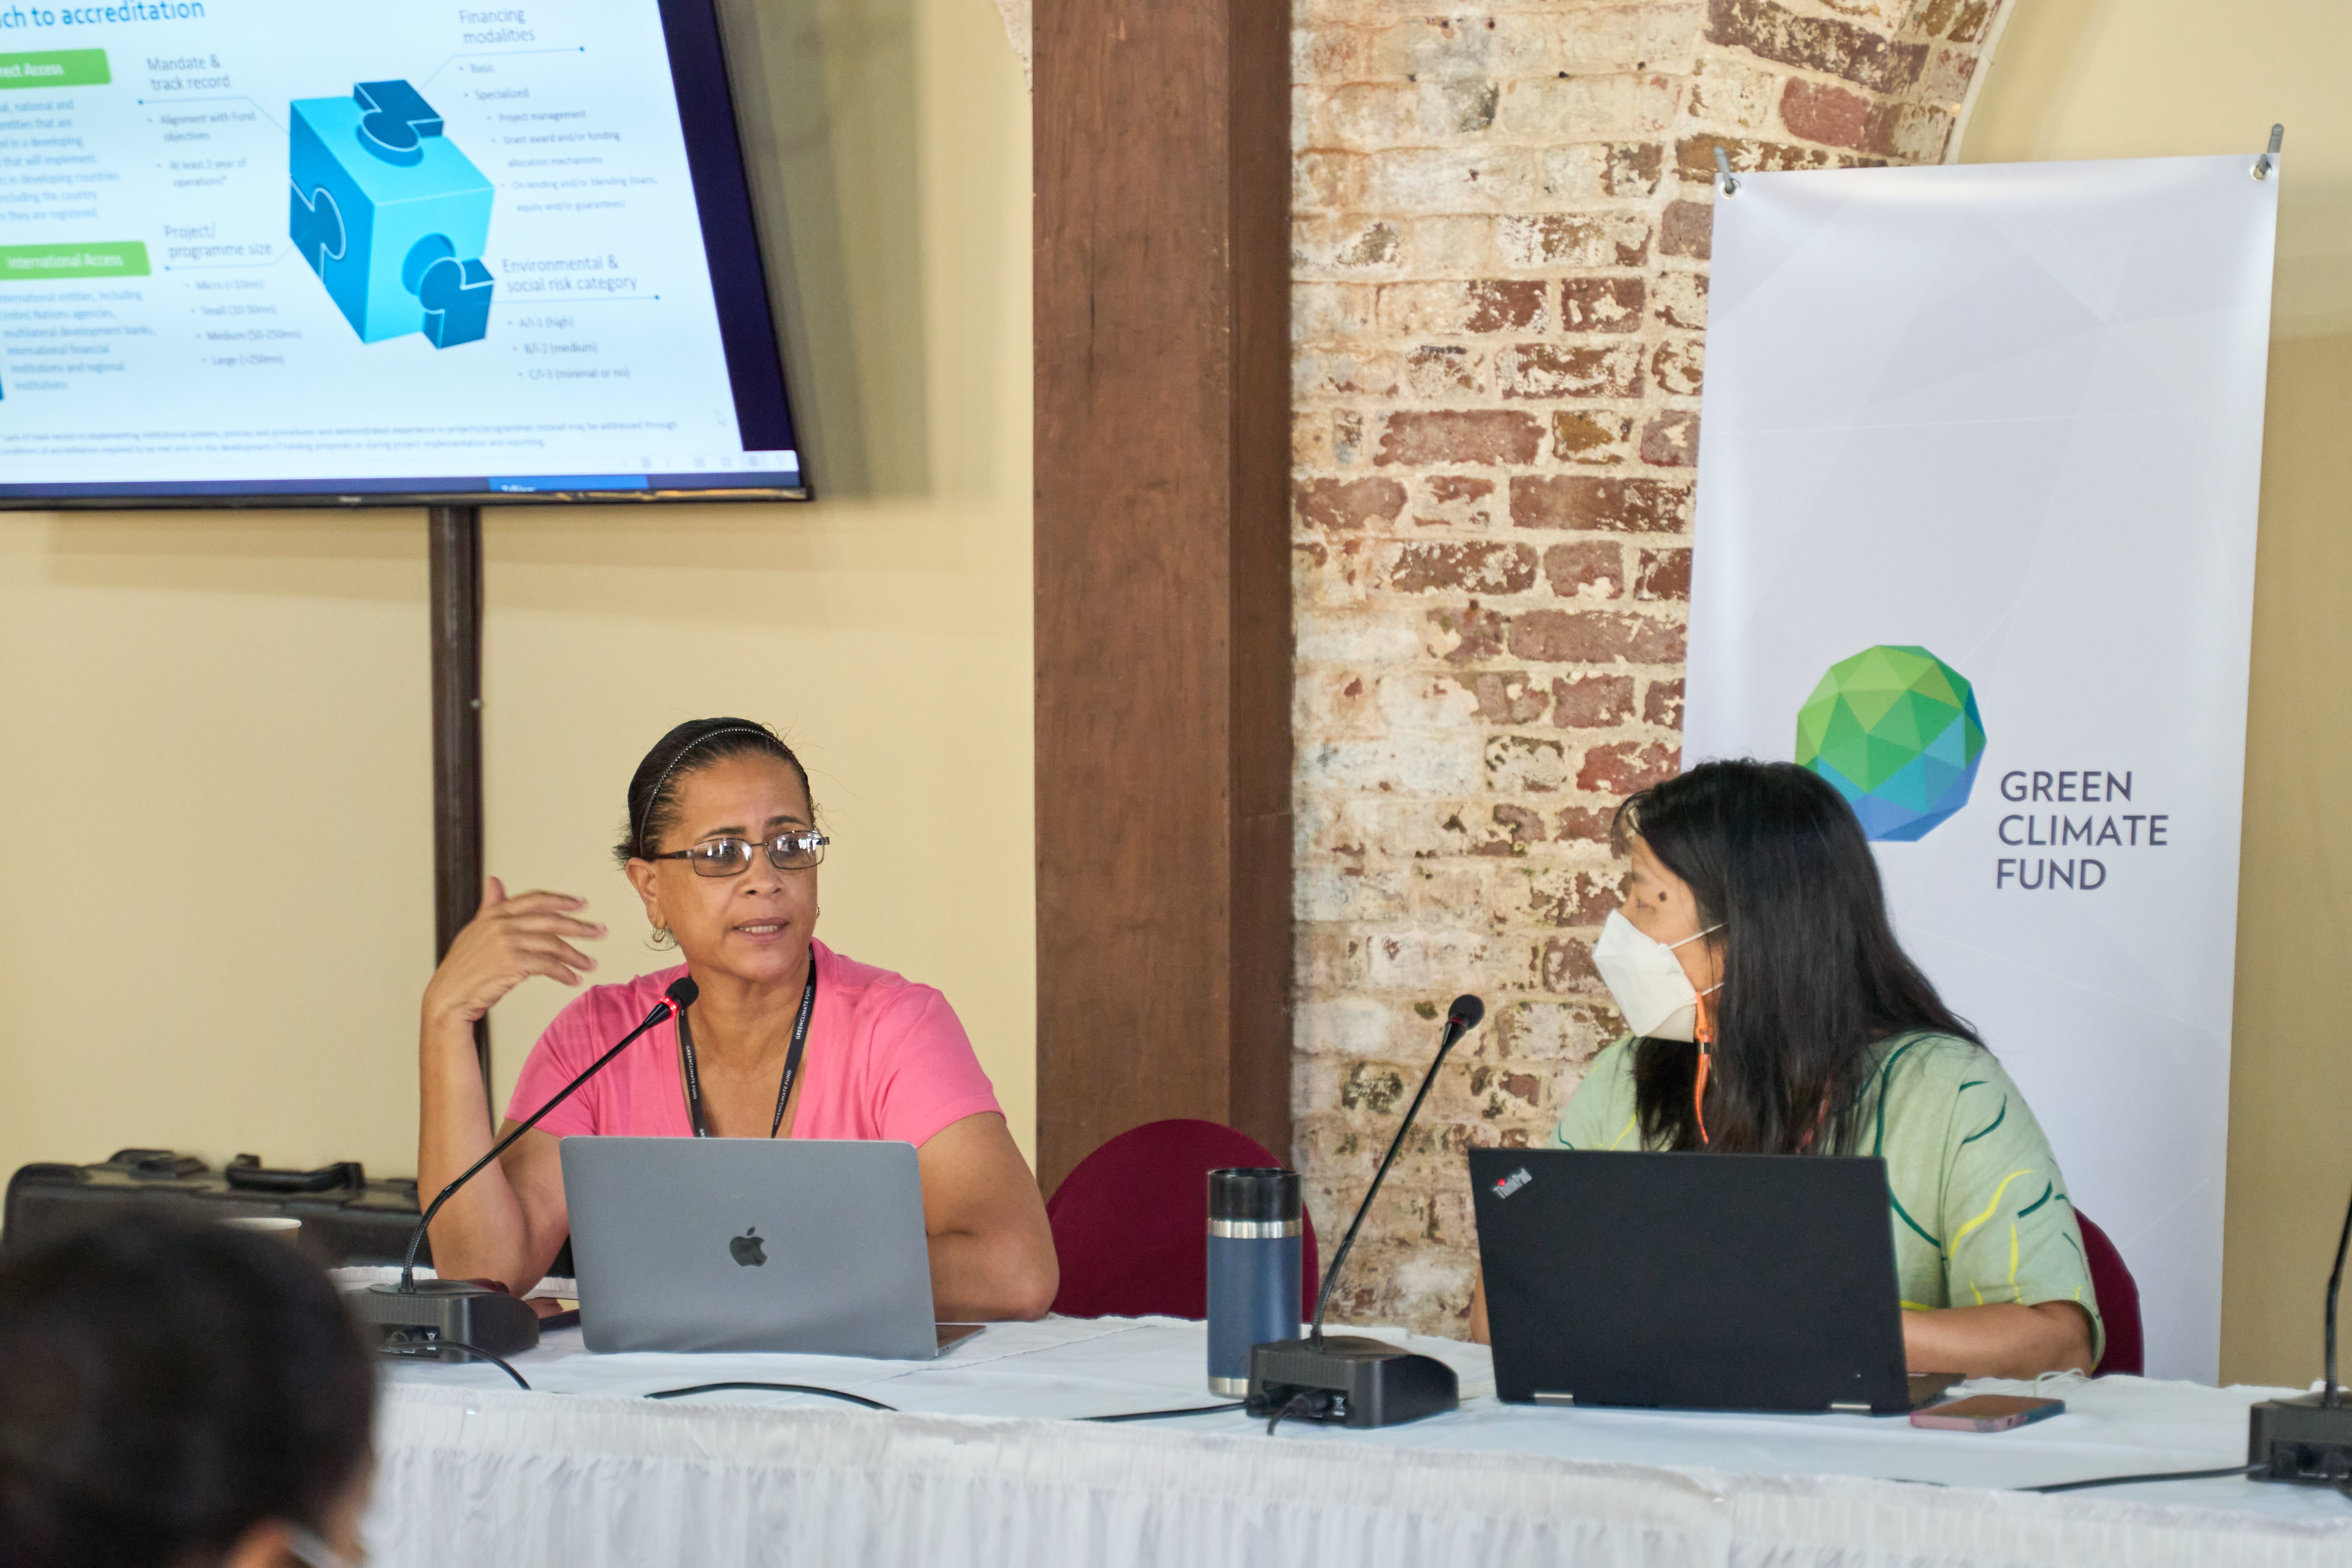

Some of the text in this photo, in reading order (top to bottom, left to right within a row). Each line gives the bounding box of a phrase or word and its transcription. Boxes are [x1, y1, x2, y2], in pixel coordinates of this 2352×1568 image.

[0, 0, 205, 28] ch to accreditation
[459, 9, 526, 24] Financing
[463, 29, 535, 44] modalities
[24, 62, 64, 76] Access
[146, 54, 221, 72] Mandate &
[470, 64, 495, 73] Basic
[151, 74, 231, 91] track record
[475, 87, 530, 100] Specialized
[164, 223, 216, 240] Project/
[169, 243, 273, 260] programme size
[7, 252, 123, 270] International Access
[502, 254, 619, 273] Environmental &
[507, 277, 637, 293] social risk category
[2000, 771, 2132, 802] GREEN
[1999, 814, 2169, 846] CLIMATE
[1997, 858, 2107, 890] FUND
